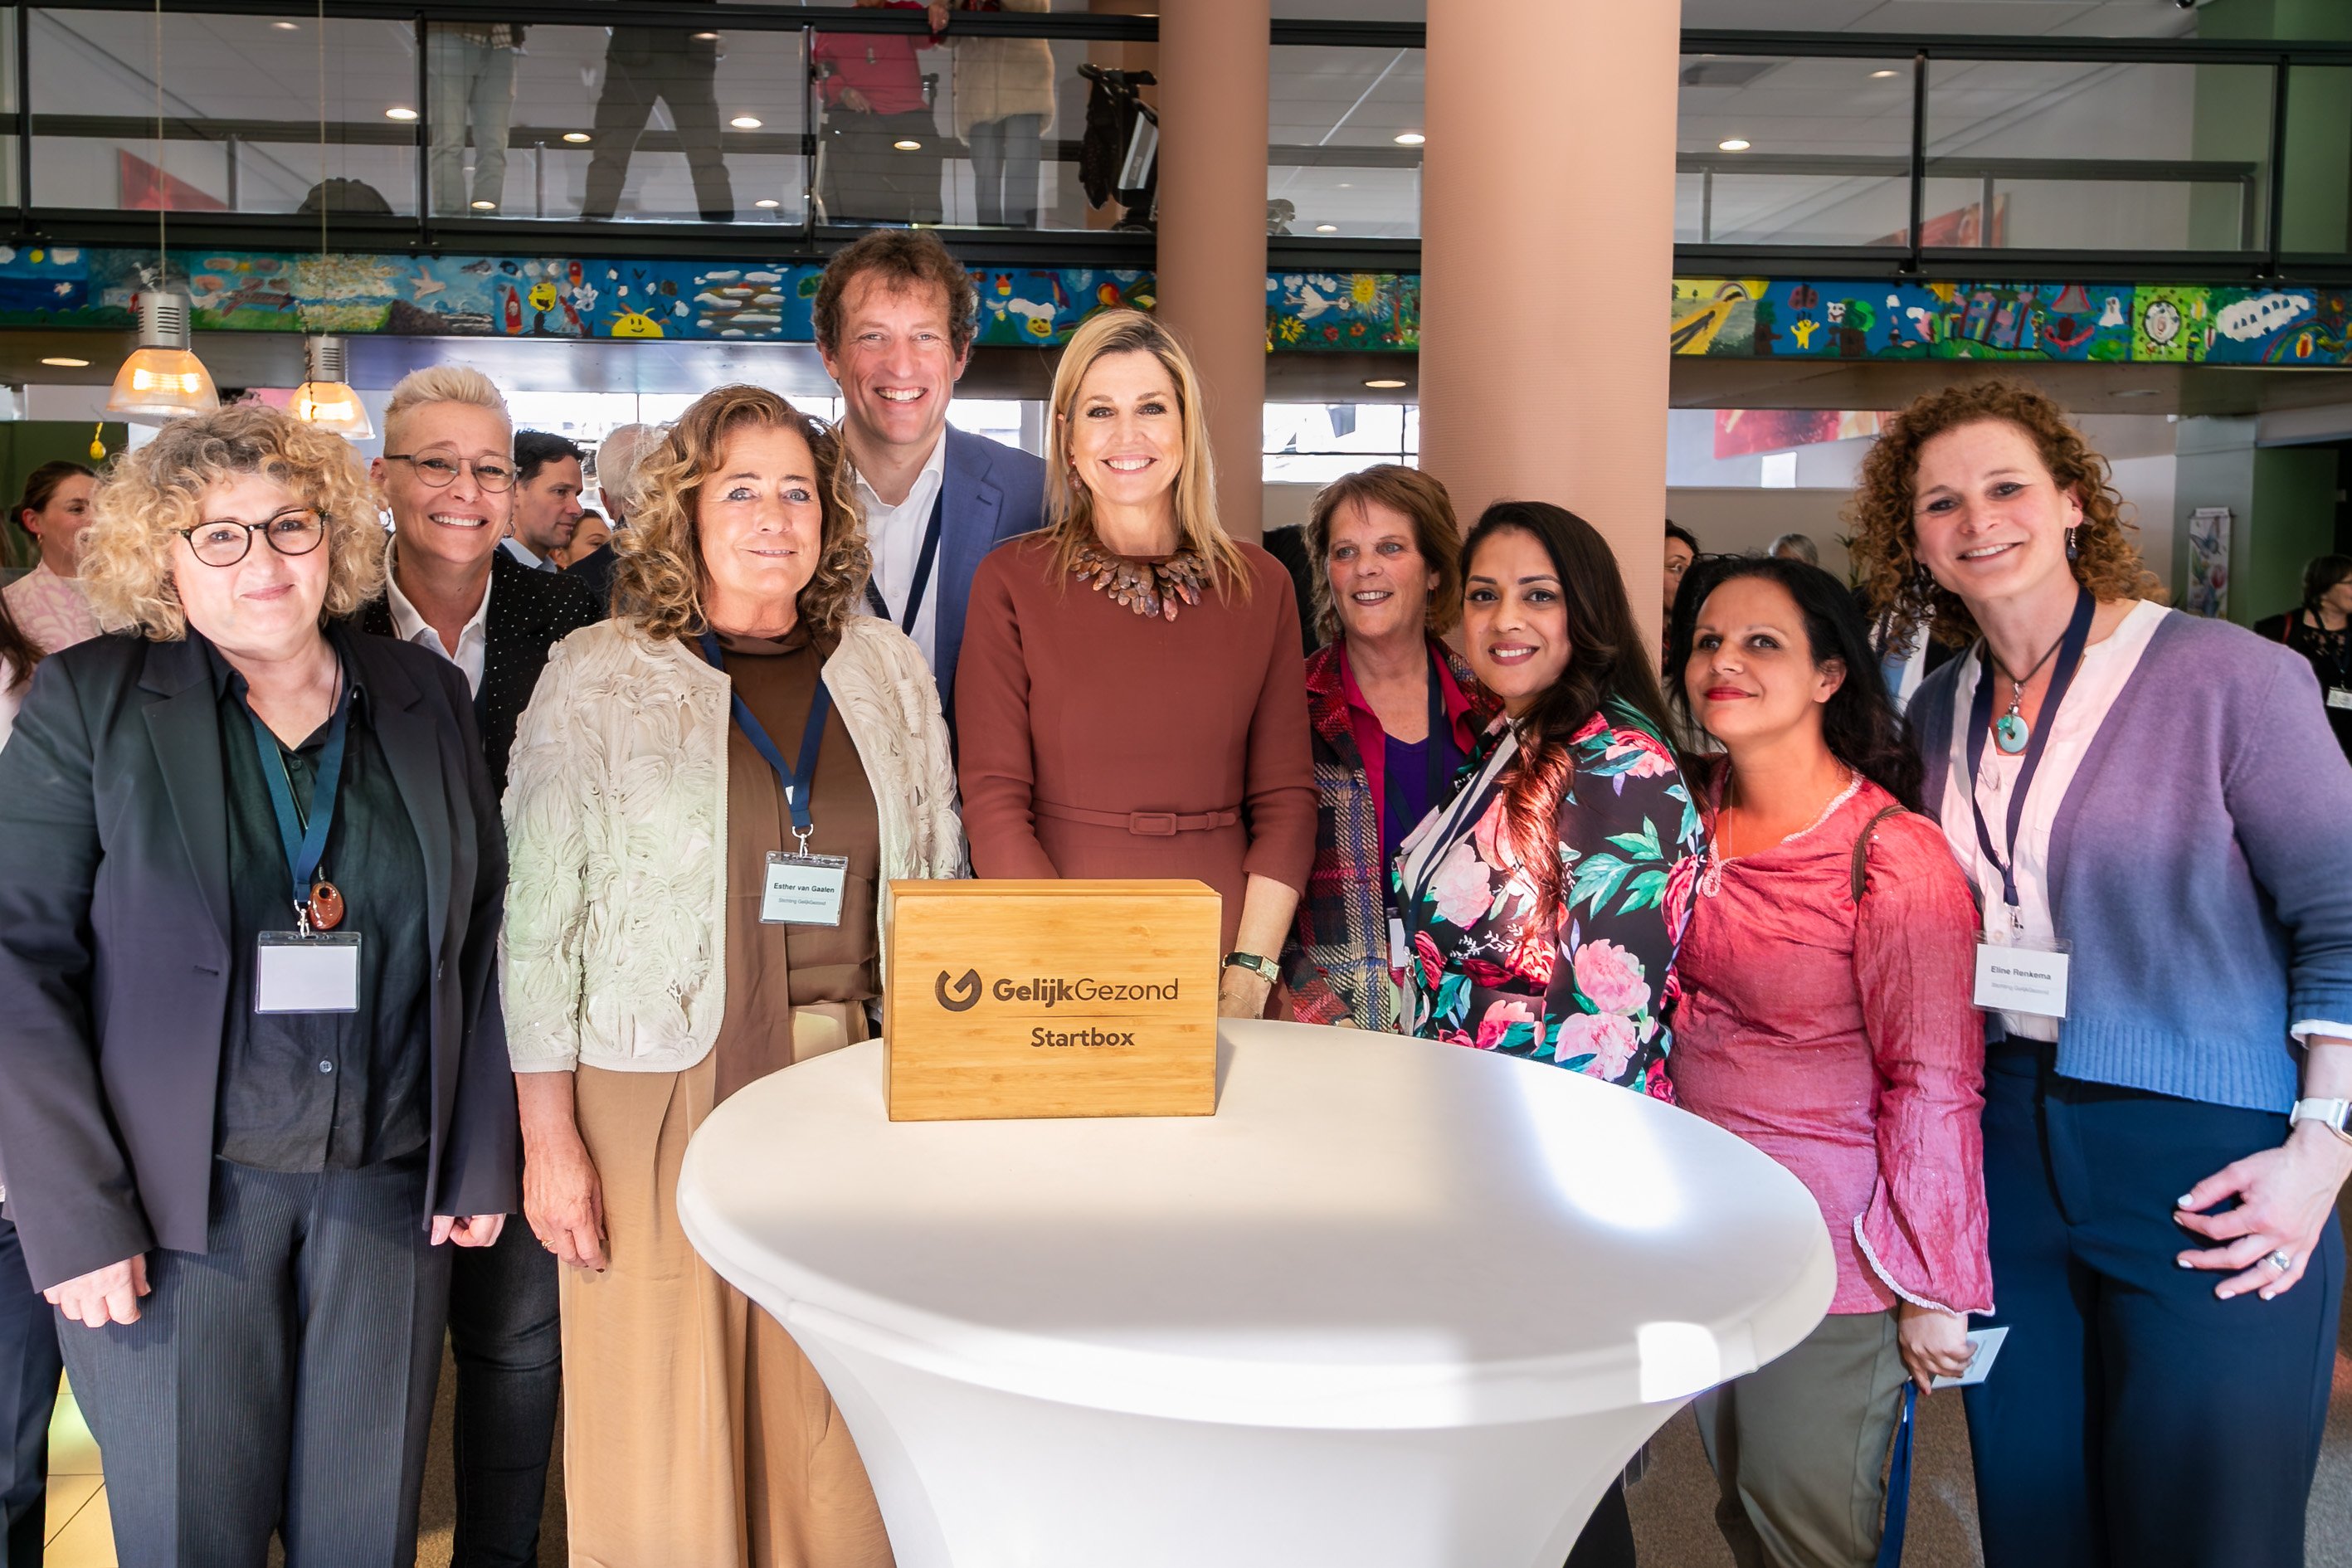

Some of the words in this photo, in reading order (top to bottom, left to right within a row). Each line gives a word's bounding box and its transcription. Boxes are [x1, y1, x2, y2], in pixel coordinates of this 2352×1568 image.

[1991, 966, 2011, 975] Eline
[2014, 968, 2051, 980] Renkema
[992, 977, 1179, 1008] GelijkGezond
[1030, 1027, 1136, 1048] Startbox
